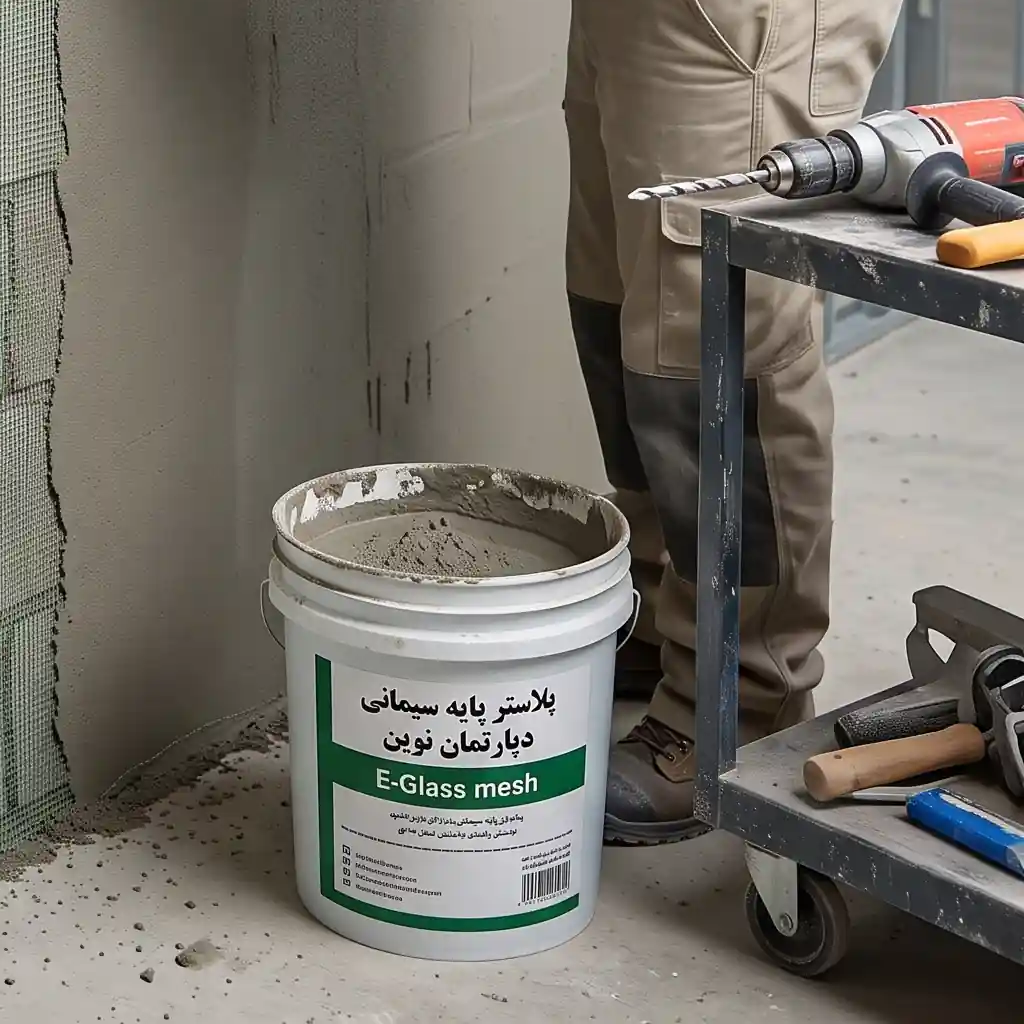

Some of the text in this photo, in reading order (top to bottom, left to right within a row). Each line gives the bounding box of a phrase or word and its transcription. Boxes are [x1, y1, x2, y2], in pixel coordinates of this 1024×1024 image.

[361, 687, 556, 726] پلاستر پایه سیمانی
[383, 728, 535, 759] دپارتمان نوین
[376, 767, 538, 799] E-Glass mesh
